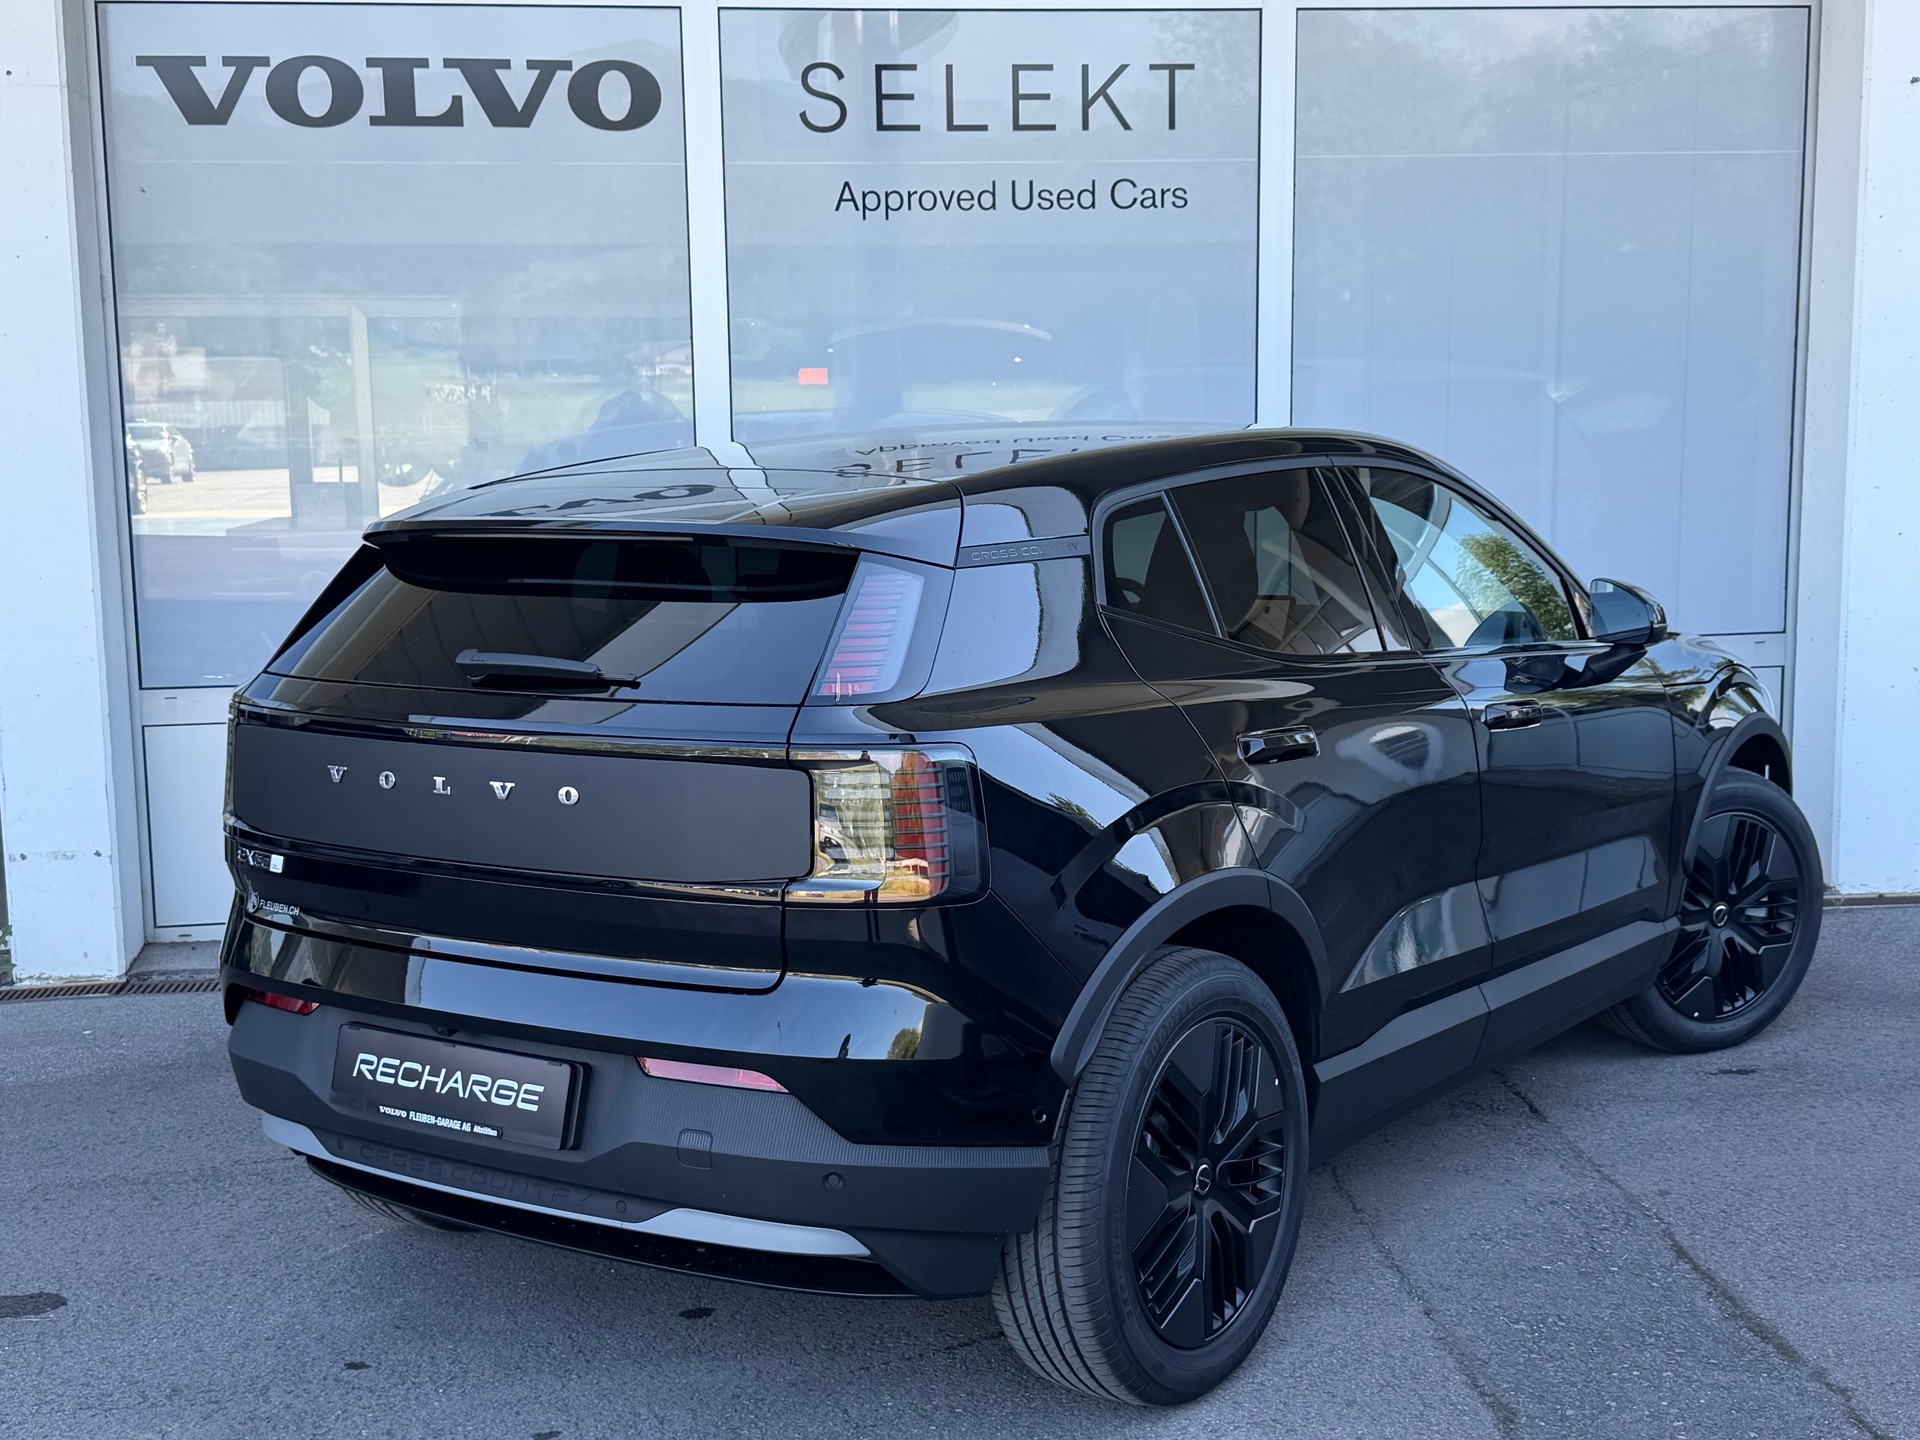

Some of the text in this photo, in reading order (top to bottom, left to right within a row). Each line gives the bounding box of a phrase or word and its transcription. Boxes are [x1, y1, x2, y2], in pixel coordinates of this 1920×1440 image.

[136, 55, 662, 131] VOLVO
[799, 62, 1195, 133] SELEKT
[835, 178, 1188, 220] Approved Used Cars
[971, 548, 1018, 561] CROSS
[327, 764, 580, 807] VOLVO
[260, 899, 300, 916] FLEUBEN.CH
[353, 1053, 545, 1112] RECHARGE
[379, 1105, 407, 1118] VOLVO
[408, 1110, 462, 1130] FLEUBEN-GARAGE
[462, 1121, 472, 1132] AG
[359, 1144, 443, 1177] CROSS
